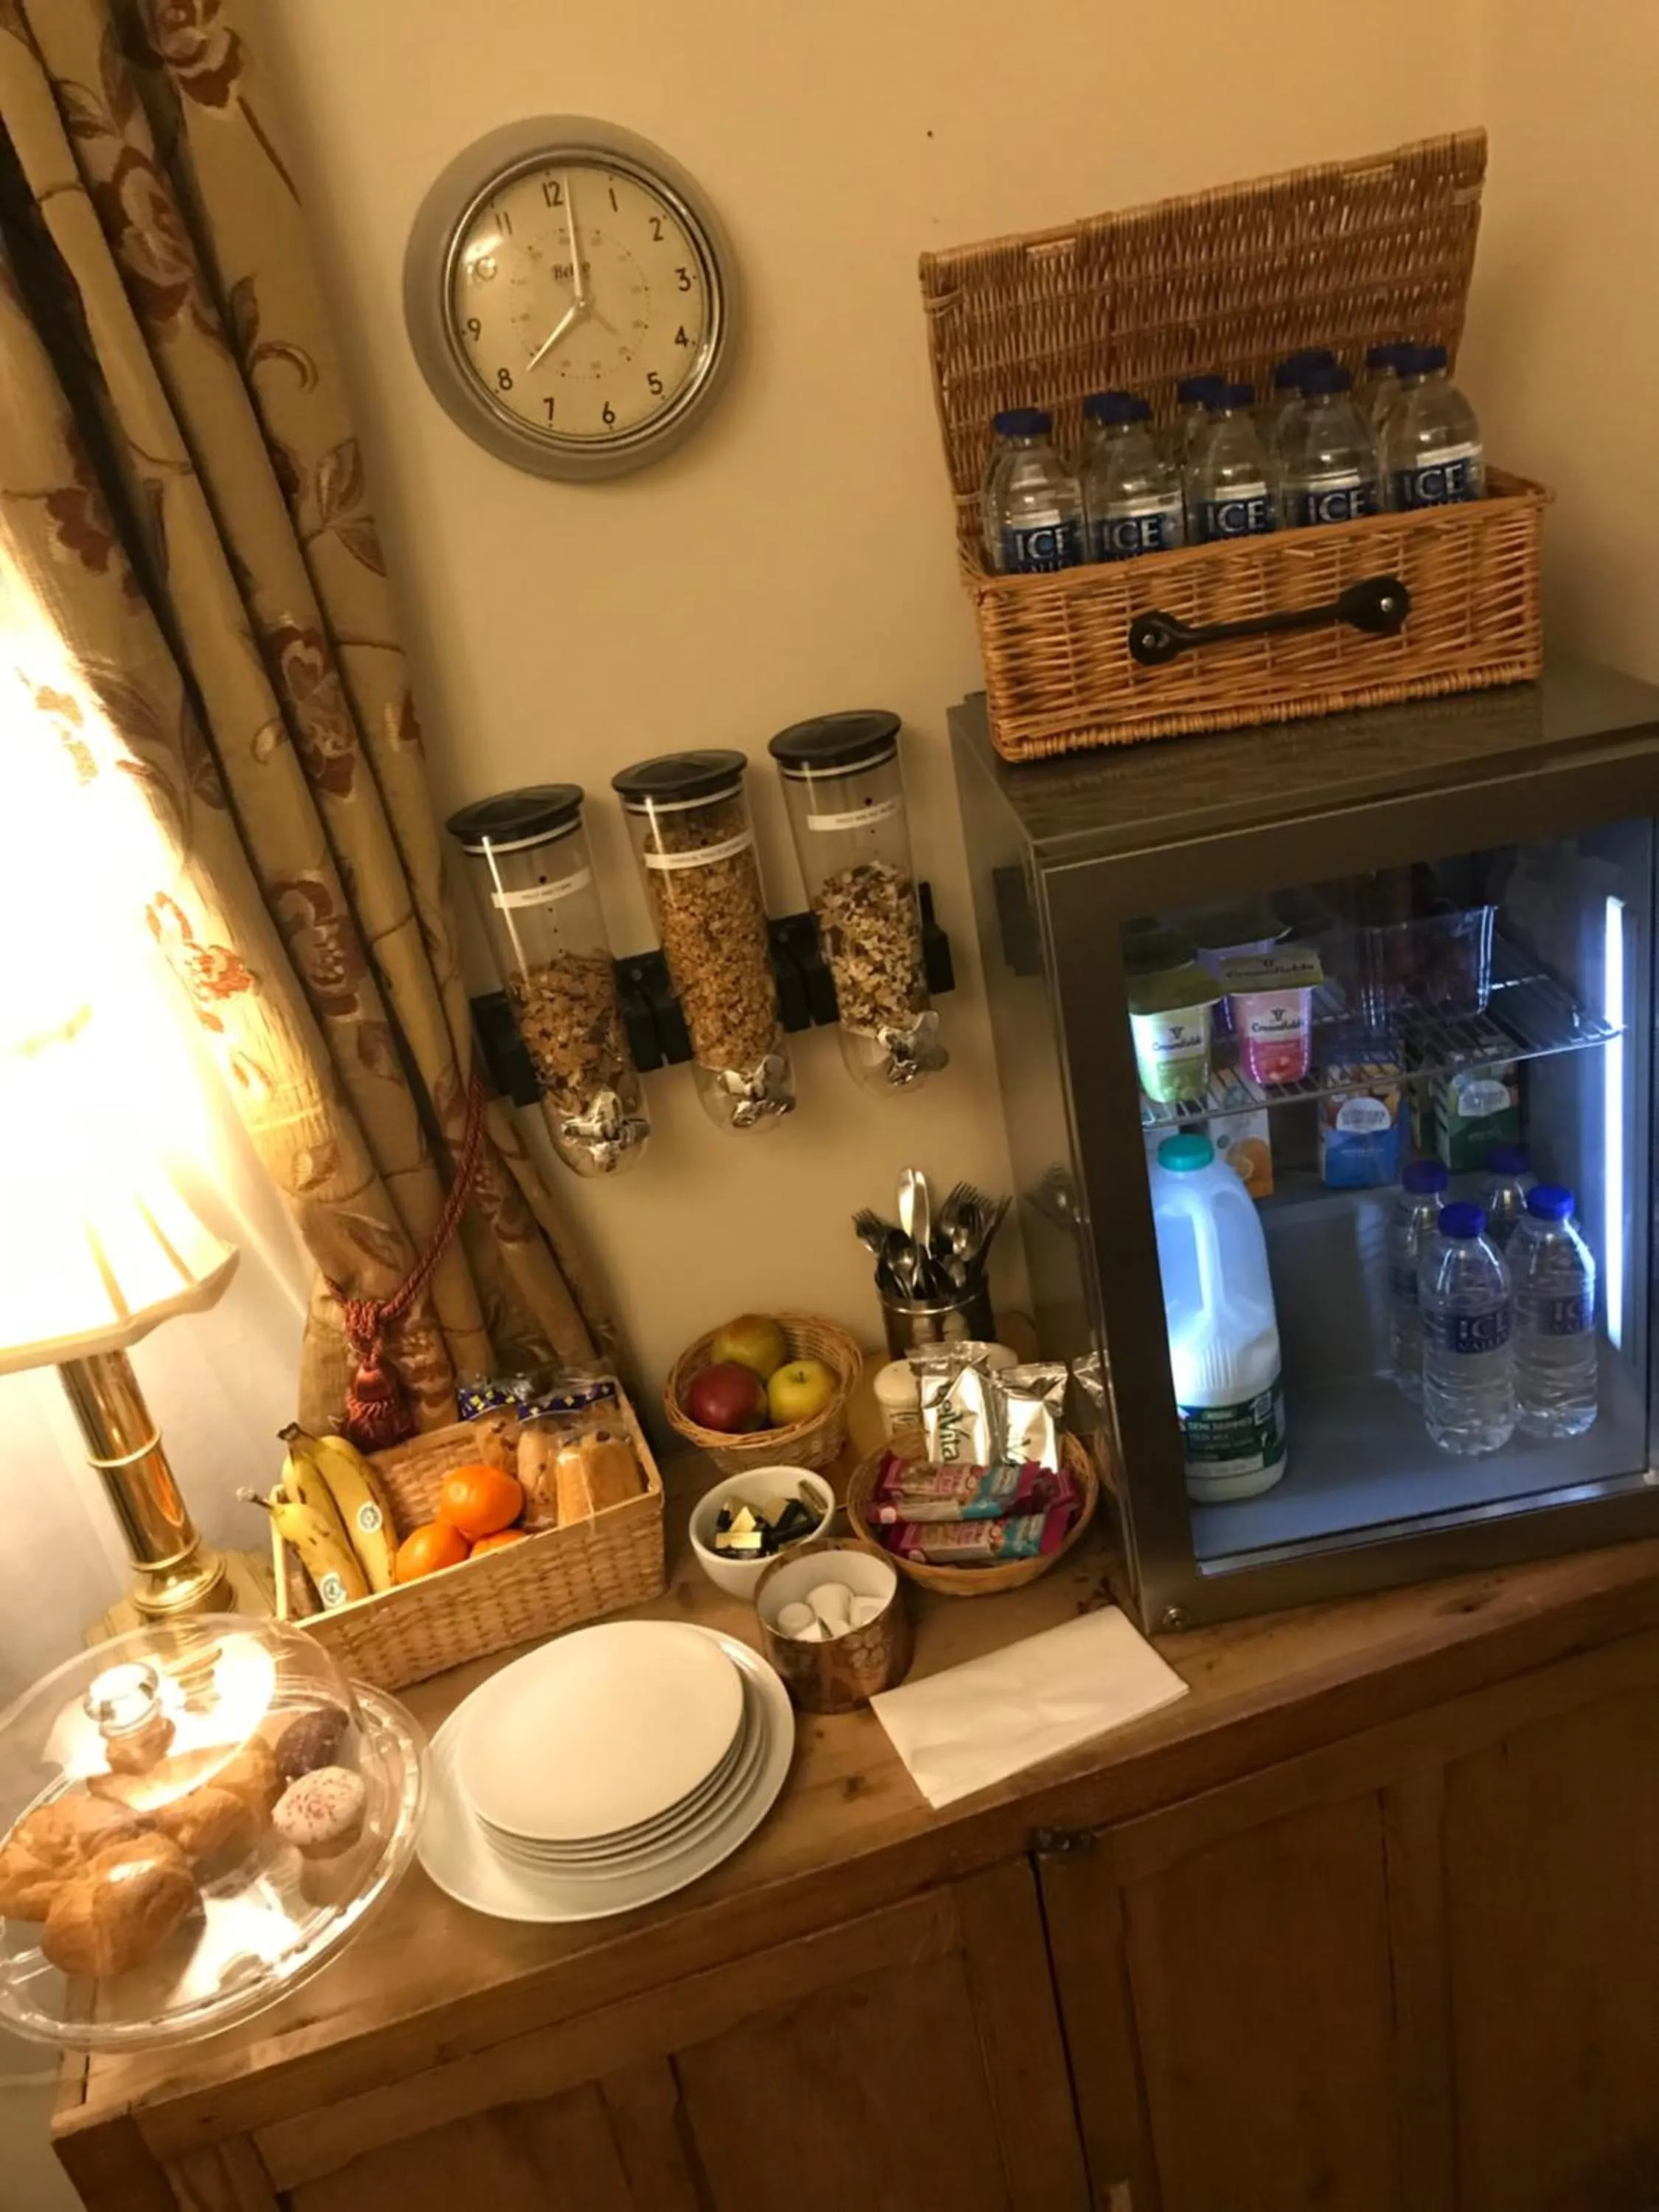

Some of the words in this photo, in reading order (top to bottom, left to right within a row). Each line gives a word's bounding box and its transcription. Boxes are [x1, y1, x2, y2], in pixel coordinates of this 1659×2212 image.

[543, 181, 564, 208] 12
[608, 188, 619, 213] 1
[495, 211, 513, 235] 11
[649, 217, 664, 242] 2
[675, 268, 691, 292] 3
[467, 318, 481, 341] 9
[674, 325, 688, 347] 4
[497, 369, 513, 392] 8
[648, 372, 664, 394] 5
[543, 397, 555, 421] 7
[602, 401, 616, 425] 6
[1403, 464, 1464, 500] ICE
[1207, 500, 1265, 533] ICE
[1308, 490, 1366, 524] ICE
[1016, 526, 1069, 560] ICE
[1103, 518, 1159, 551] ICE
